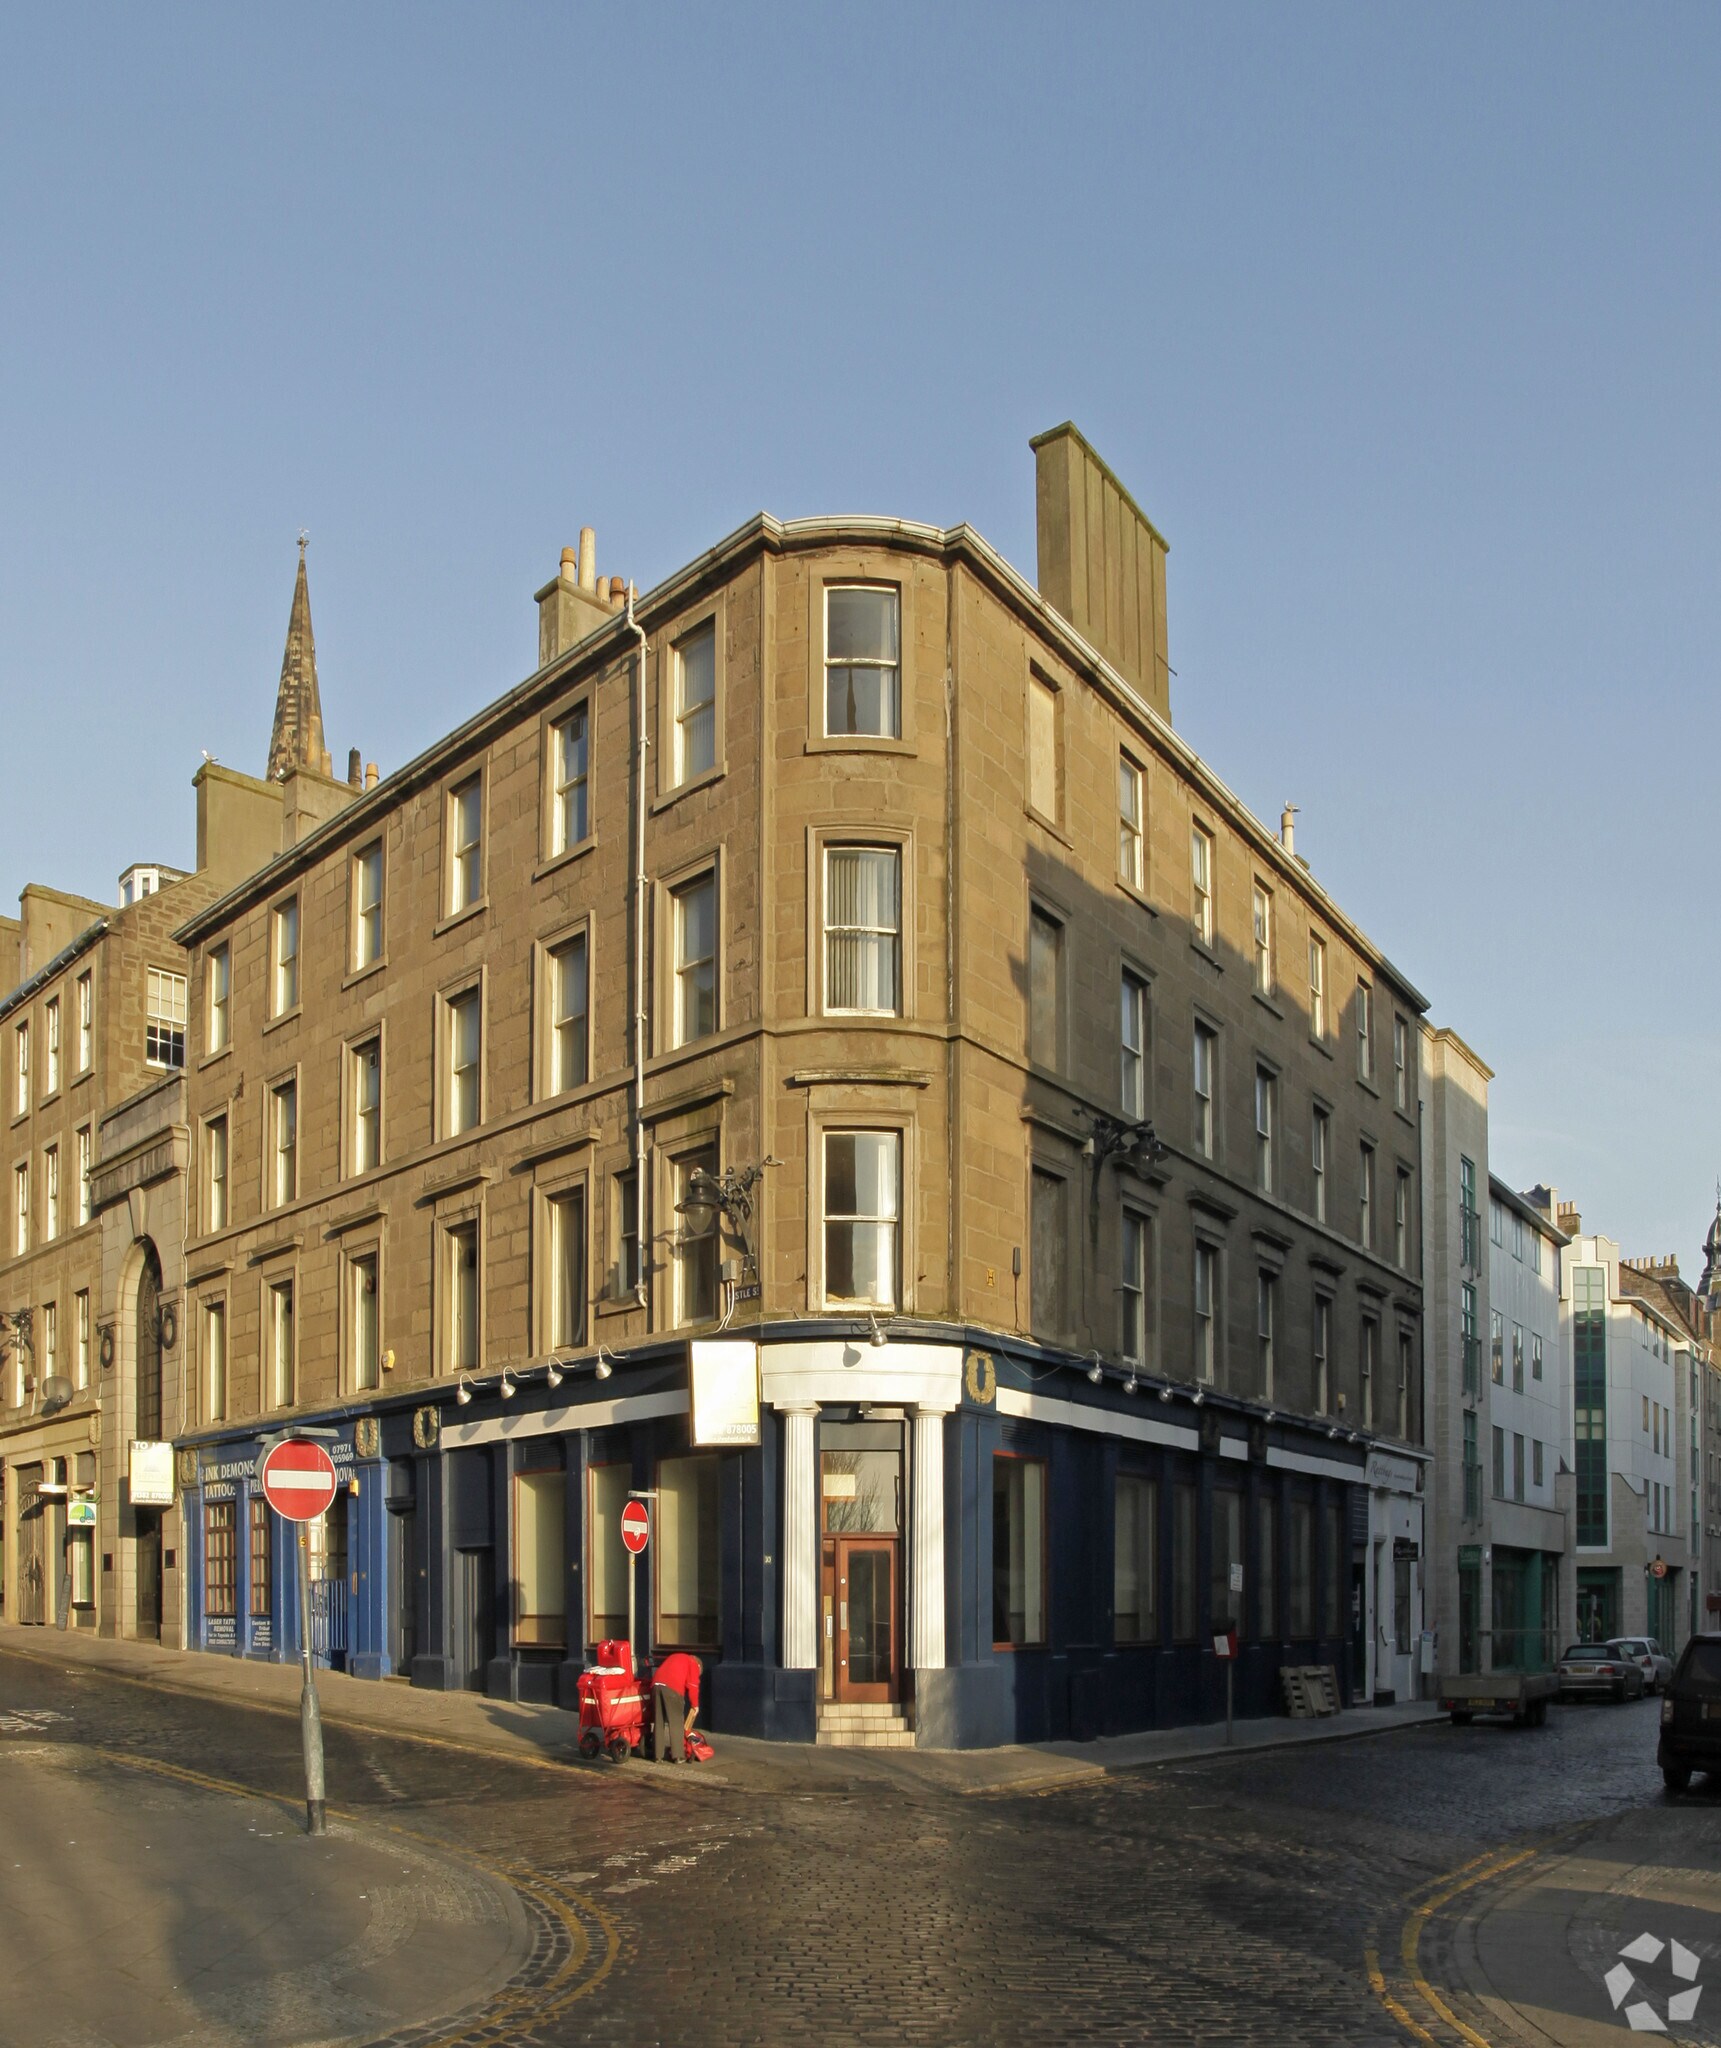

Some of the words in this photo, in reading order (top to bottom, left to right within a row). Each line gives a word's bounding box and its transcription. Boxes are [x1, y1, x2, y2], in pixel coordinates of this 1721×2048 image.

[726, 1424, 757, 1434] 878005
[133, 1441, 149, 1450] TO
[332, 1444, 351, 1454] 07971
[205, 1465, 219, 1481] INK
[220, 1460, 255, 1479] DEMONS
